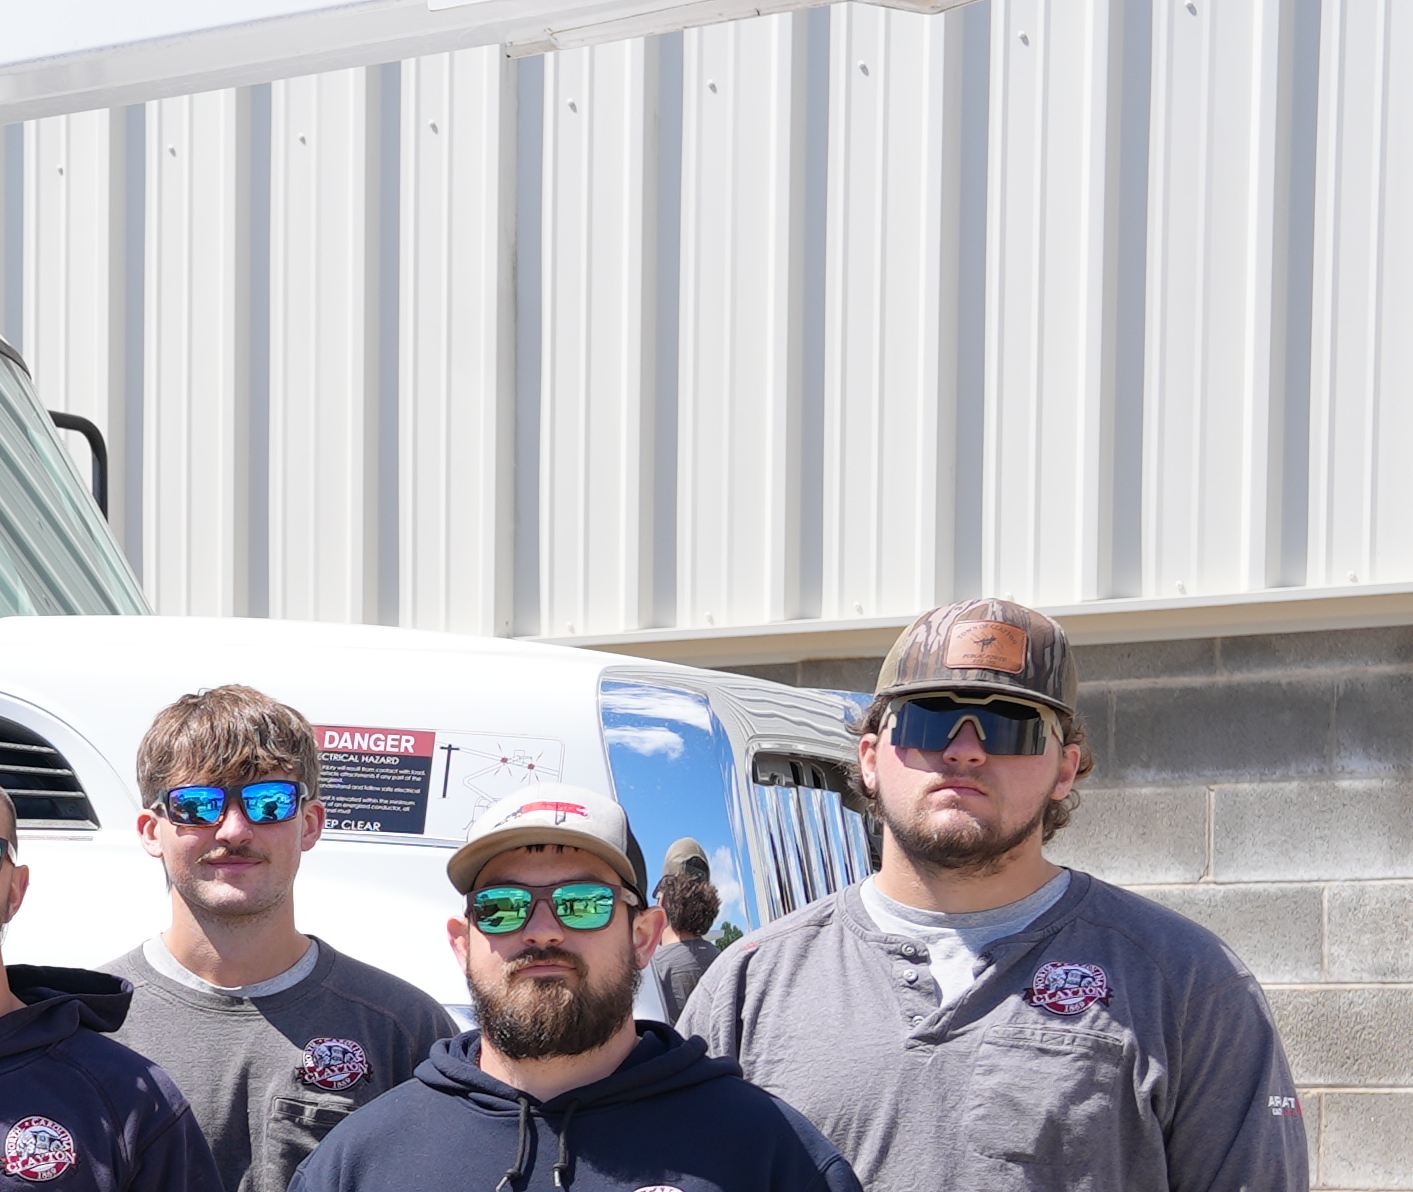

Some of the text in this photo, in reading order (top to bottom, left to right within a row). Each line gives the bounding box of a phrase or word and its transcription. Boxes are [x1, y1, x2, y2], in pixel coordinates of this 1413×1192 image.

[990, 624, 1018, 645] CLAYTON
[323, 730, 415, 753] DANGER
[316, 752, 400, 765] ECTRICAL HAZARD
[324, 819, 382, 831] EP CLEAR
[1033, 987, 1108, 1004] CLAYTON
[1064, 1001, 1085, 1013] 1869
[305, 1062, 368, 1082] CLAYTON
[31, 1118, 72, 1152] CAROLINA
[6, 1150, 76, 1173] CLAYTON
